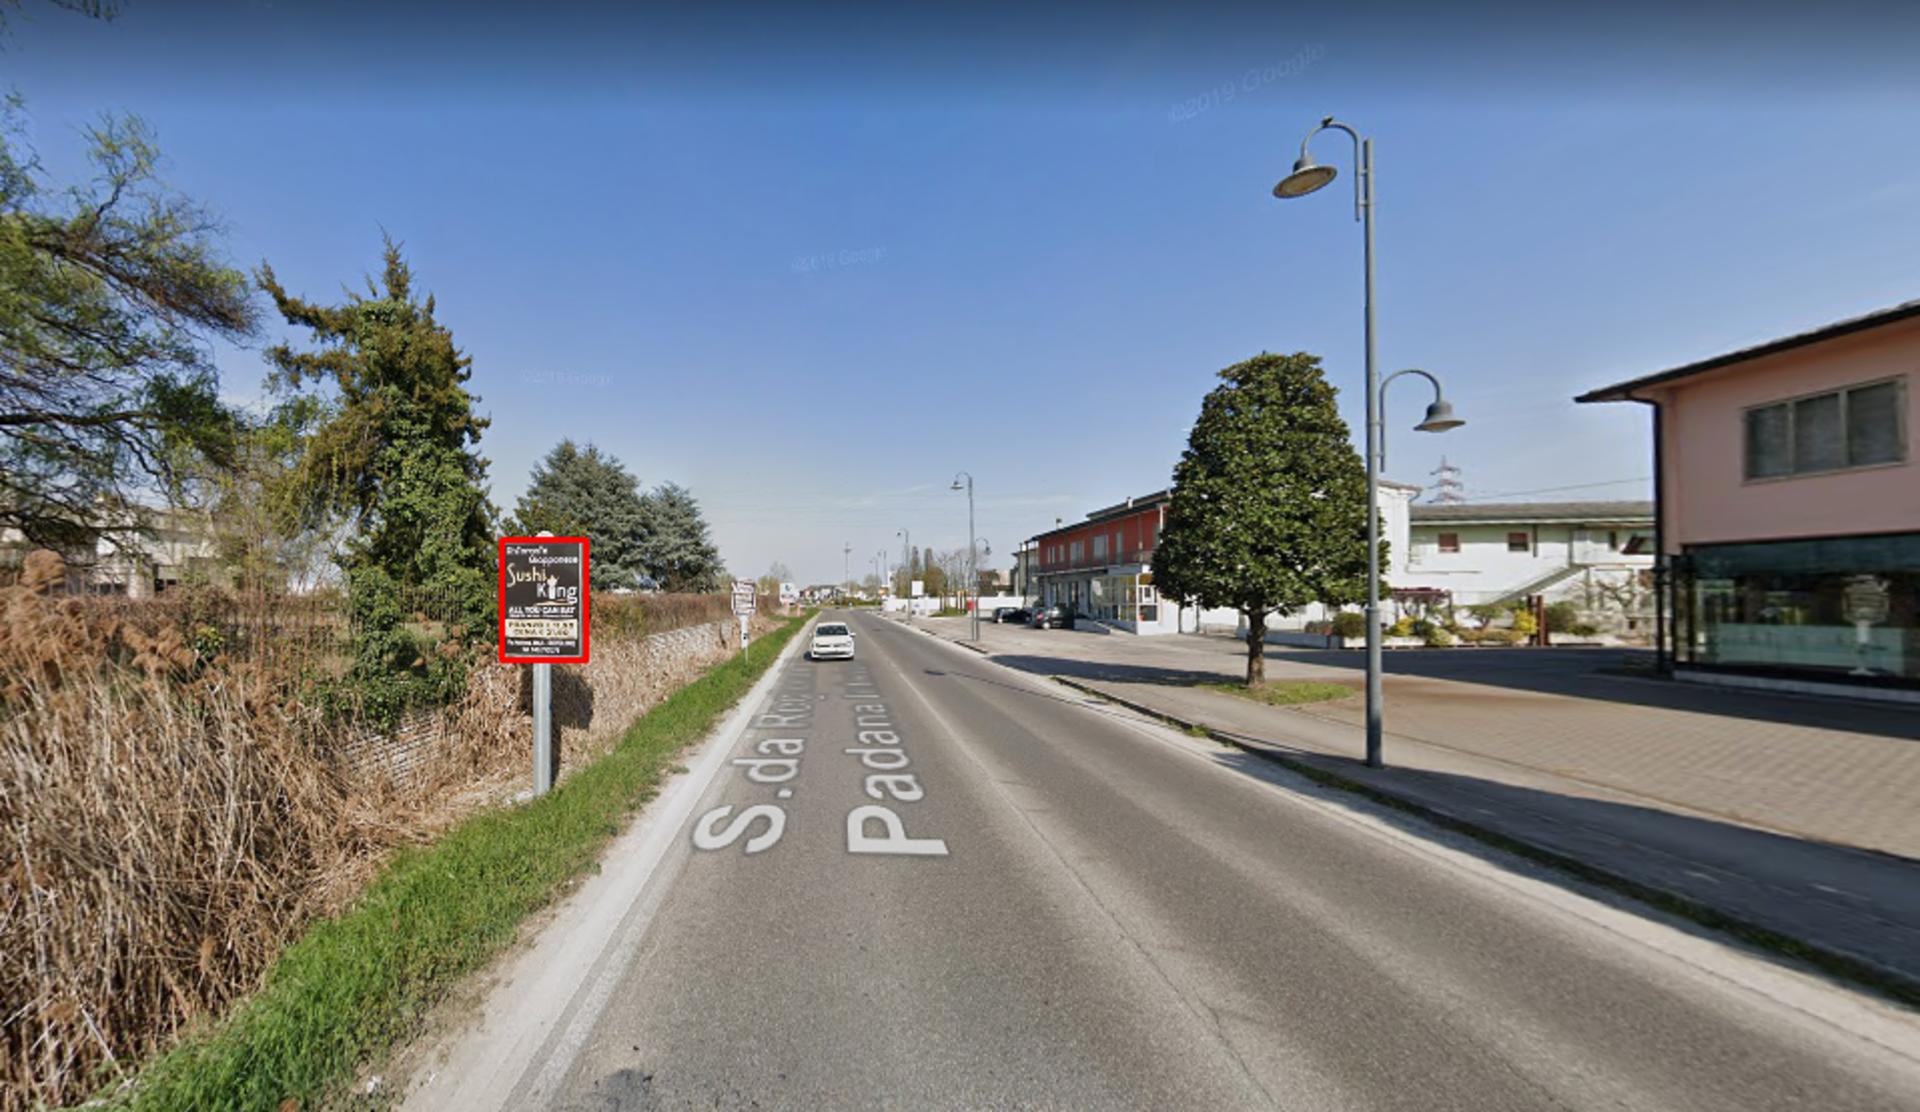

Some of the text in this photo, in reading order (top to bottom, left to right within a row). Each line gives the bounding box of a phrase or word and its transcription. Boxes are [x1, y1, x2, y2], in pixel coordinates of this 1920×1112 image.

[506, 562, 547, 588] Sushi
[536, 576, 578, 605] King
[508, 606, 576, 614] ALL YOU CAN EAT
